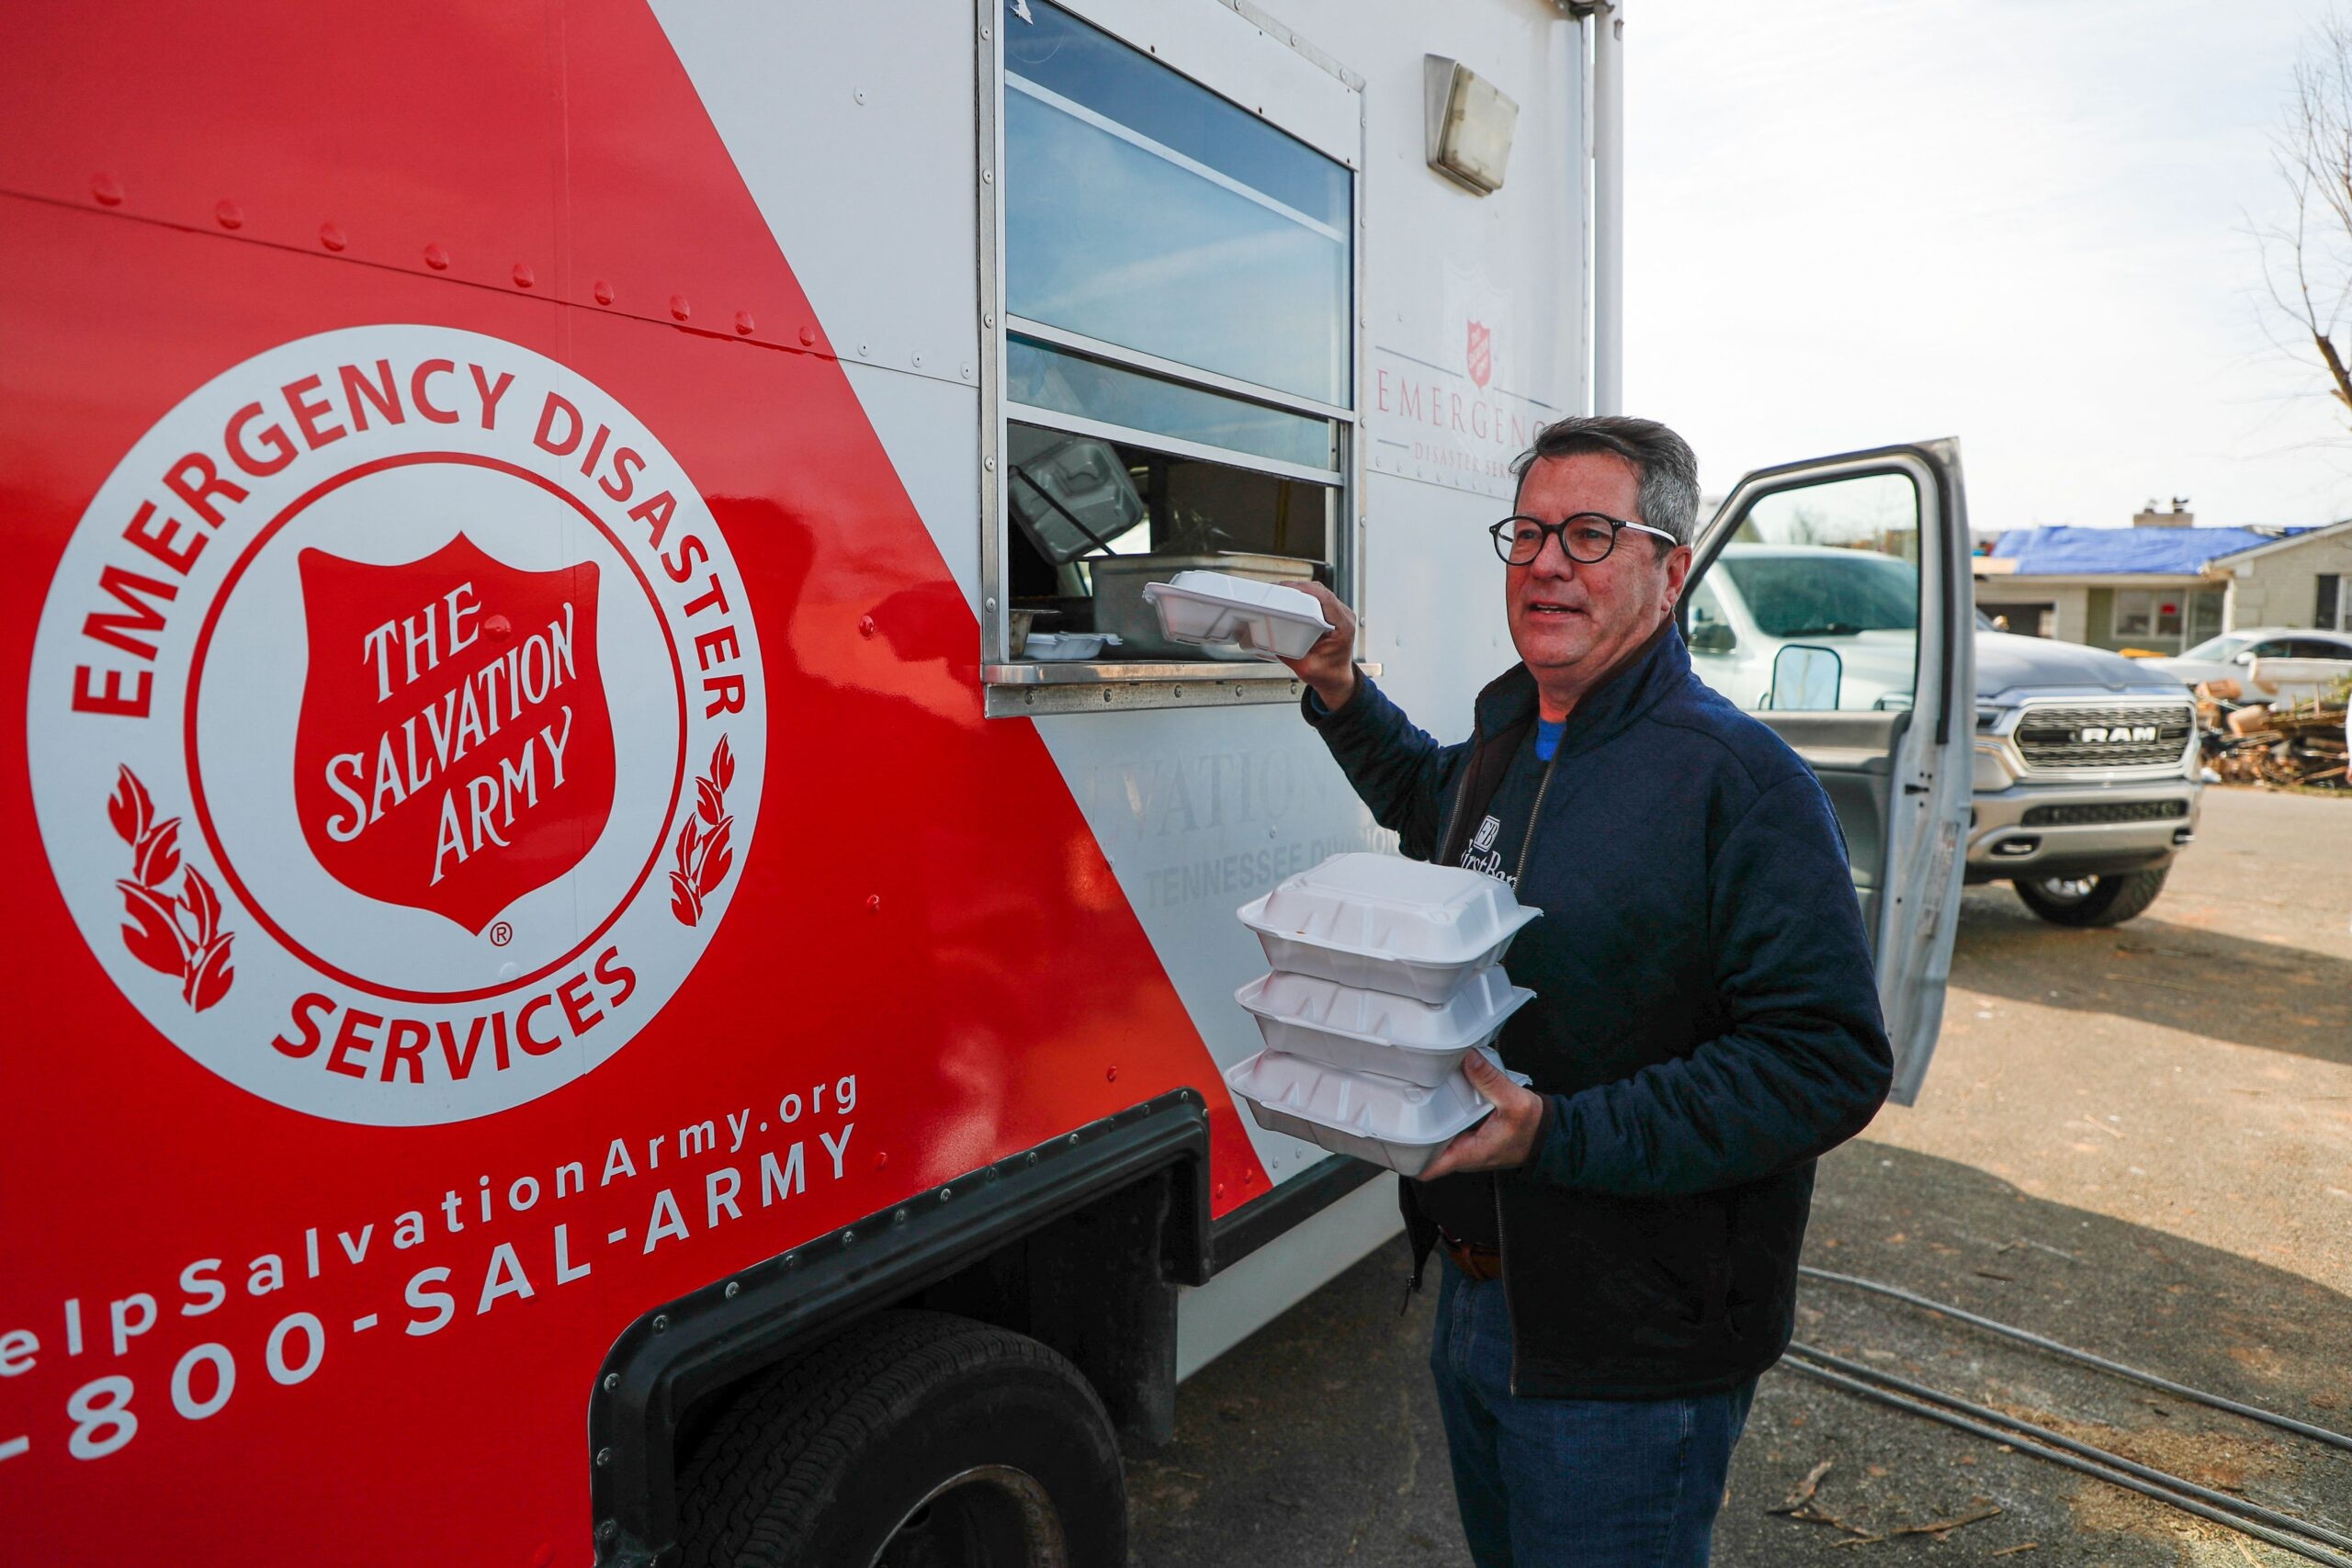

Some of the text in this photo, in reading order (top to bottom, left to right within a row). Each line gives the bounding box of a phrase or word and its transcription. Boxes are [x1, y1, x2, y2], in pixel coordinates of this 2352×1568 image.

[1414, 441, 1517, 481] DISASTER SER
[73, 359, 745, 718] EMERGENCY DISASTER
[365, 582, 481, 702] THE
[326, 603, 575, 841] SALVATION
[2081, 727, 2157, 743] RAM
[431, 706, 571, 886] ARMY
[1143, 842, 1304, 909] TENNESSEE
[272, 946, 636, 1083] SERVICES
[0, 1075, 856, 1377] elpSalvationArmy.org
